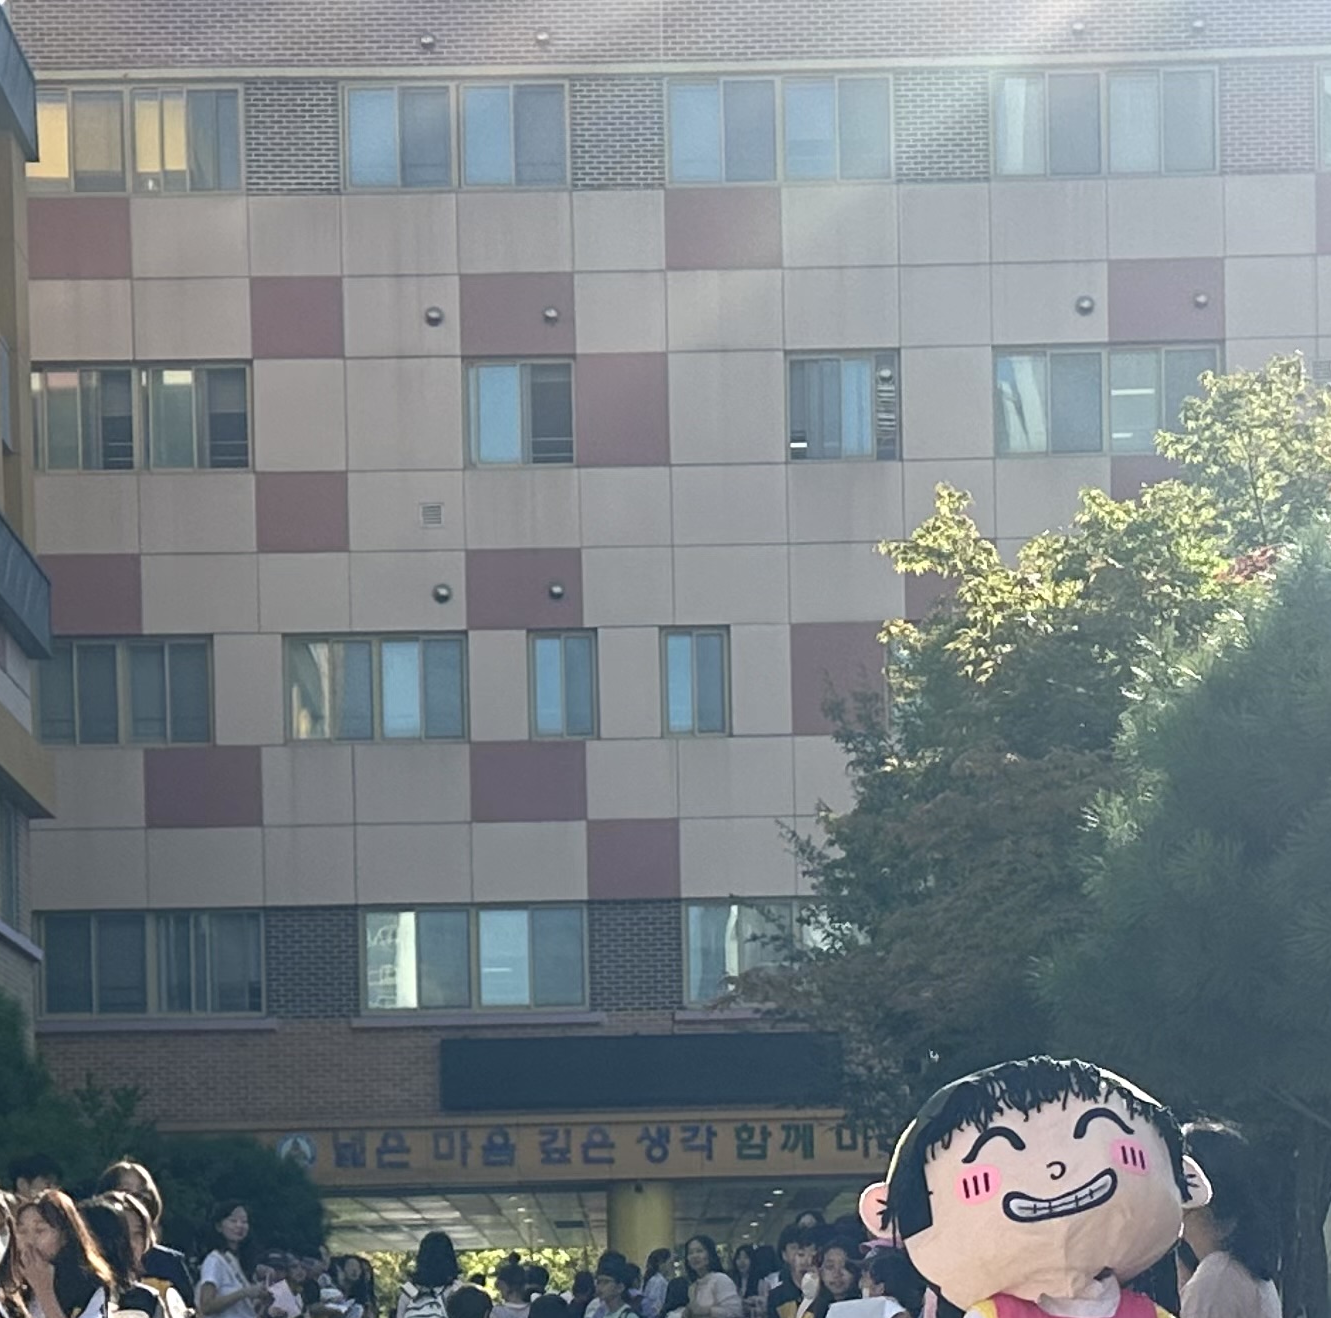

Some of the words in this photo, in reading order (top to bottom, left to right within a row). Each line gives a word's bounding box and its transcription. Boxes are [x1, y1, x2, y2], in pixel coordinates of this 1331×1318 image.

[330, 1128, 412, 1170] 넓은
[432, 1126, 518, 1168] 마음
[537, 1125, 617, 1166] 깊은
[635, 1123, 718, 1164] 생각
[734, 1121, 816, 1160] 함께
